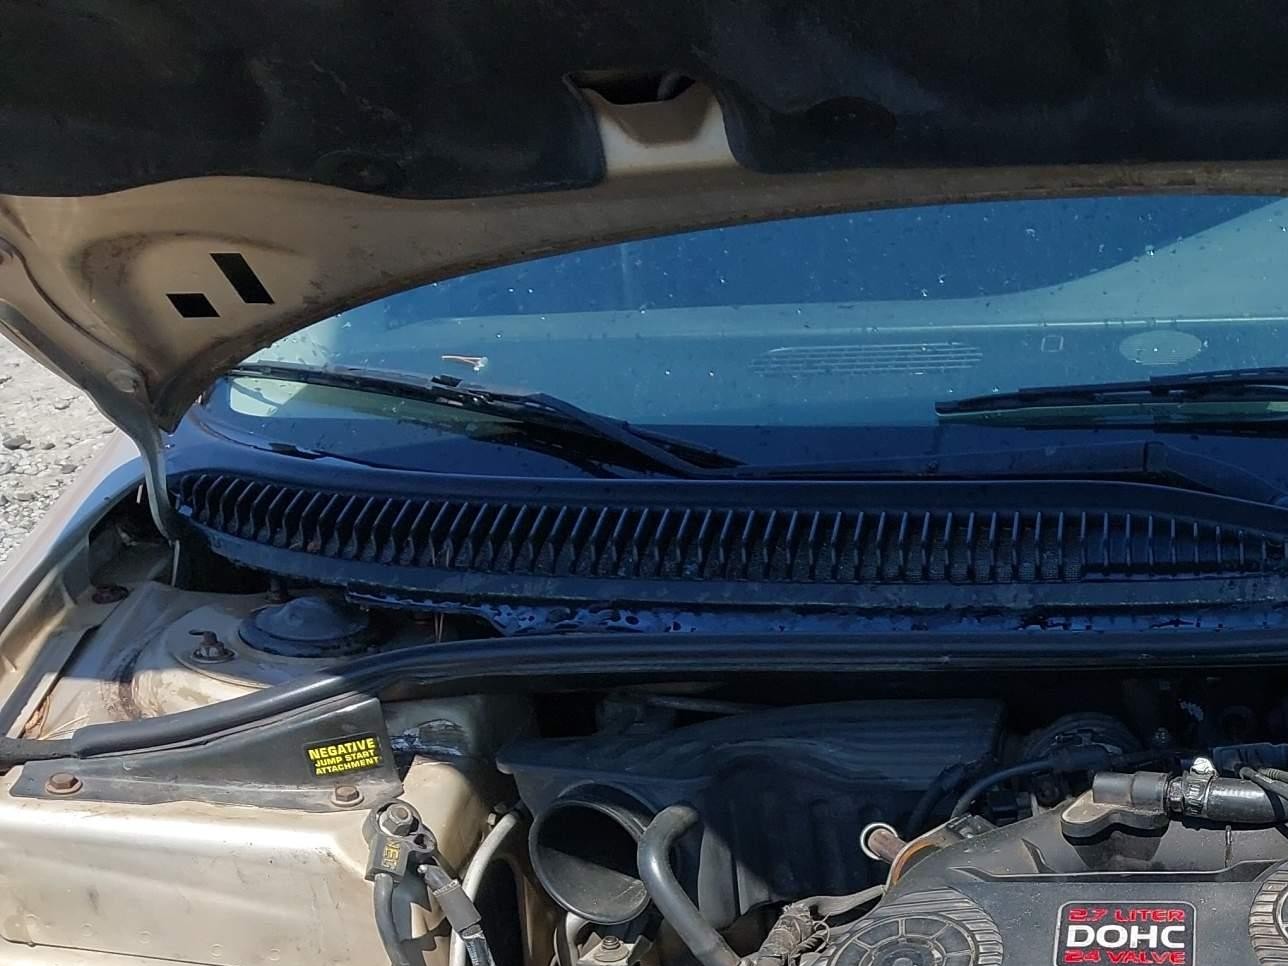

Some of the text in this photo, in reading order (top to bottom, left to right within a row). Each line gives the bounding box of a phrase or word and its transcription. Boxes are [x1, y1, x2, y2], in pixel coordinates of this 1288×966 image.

[308, 737, 376, 760] NEGATIVE
[314, 749, 375, 768] JUMP START
[315, 756, 379, 775] ATTACHMENT
[1068, 908, 1185, 923] 2.7 LITER
[1066, 924, 1185, 949] DOHC
[1063, 950, 1186, 966] 24 VALVE
